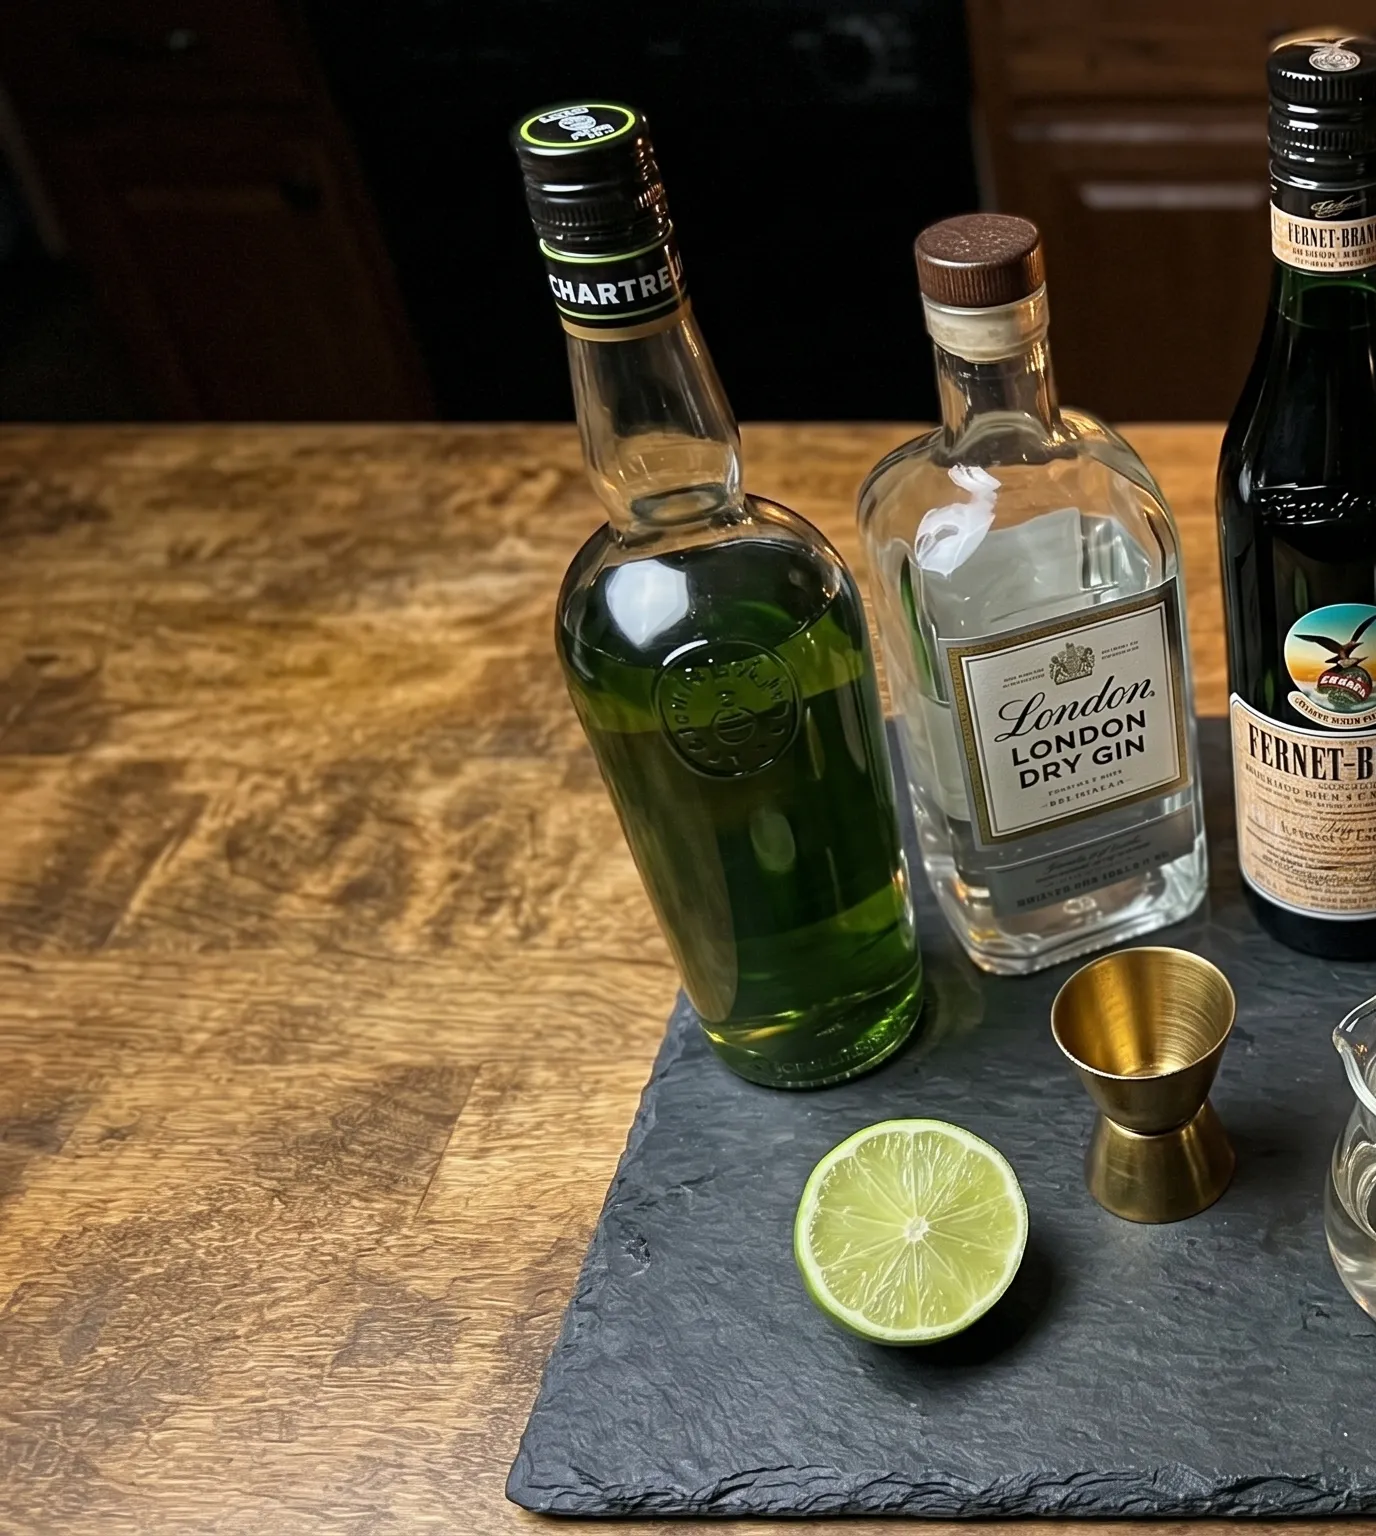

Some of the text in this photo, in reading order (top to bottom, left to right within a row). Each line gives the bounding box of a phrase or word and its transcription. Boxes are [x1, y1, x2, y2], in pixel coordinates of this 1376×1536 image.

[549, 251, 684, 305] CHARTREU
[1011, 709, 1147, 767] LONDON
[1019, 753, 1082, 790] DRY
[1091, 734, 1145, 766] GIN
